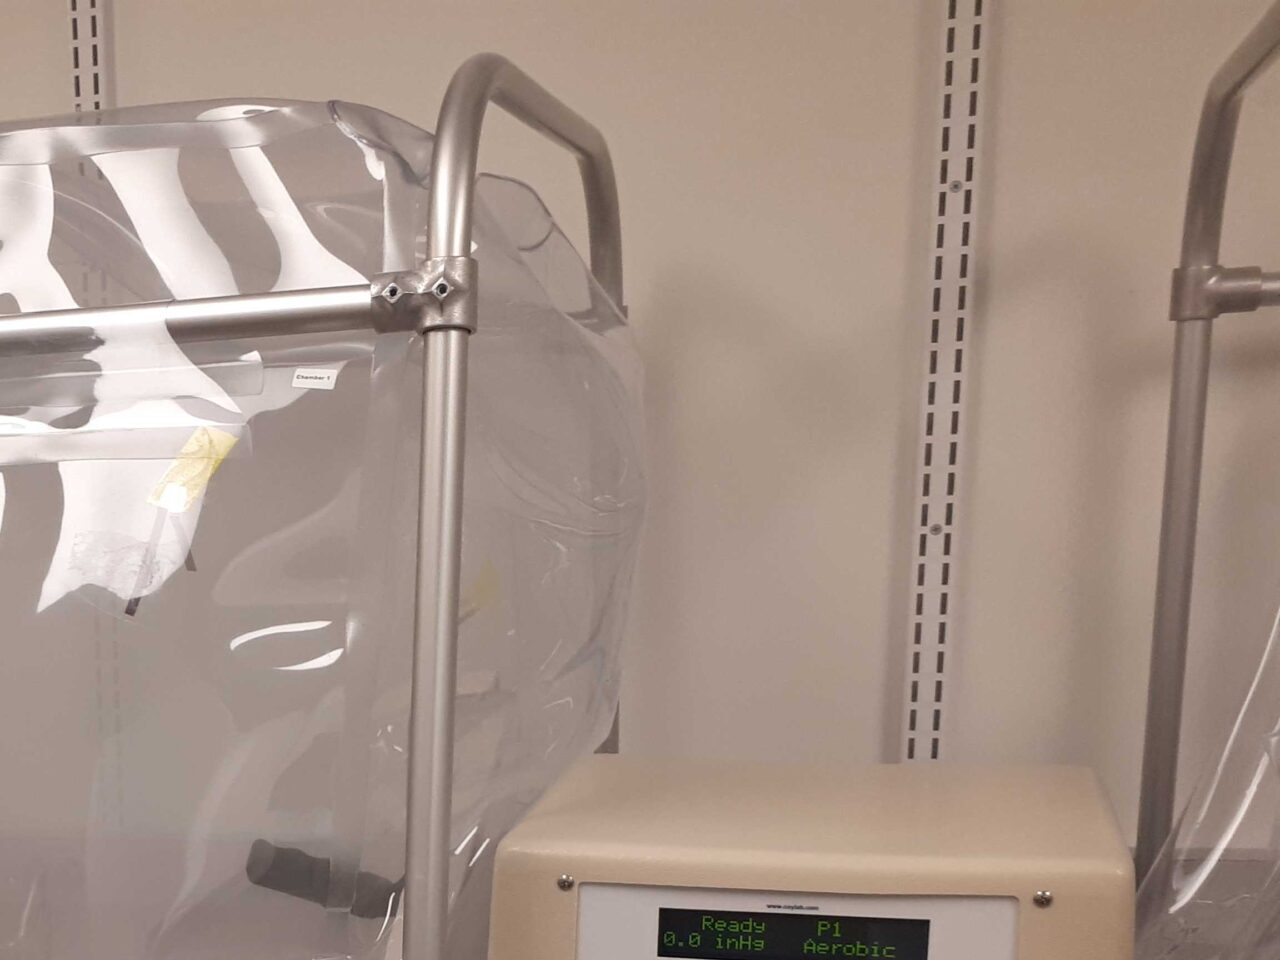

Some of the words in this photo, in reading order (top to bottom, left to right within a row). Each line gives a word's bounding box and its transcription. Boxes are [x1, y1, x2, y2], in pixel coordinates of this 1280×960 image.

[702, 915, 765, 934] Ready
[817, 920, 842, 938] P1
[663, 931, 701, 948] 0.0
[716, 934, 765, 951] inHg
[803, 938, 896, 958] Aerobic
